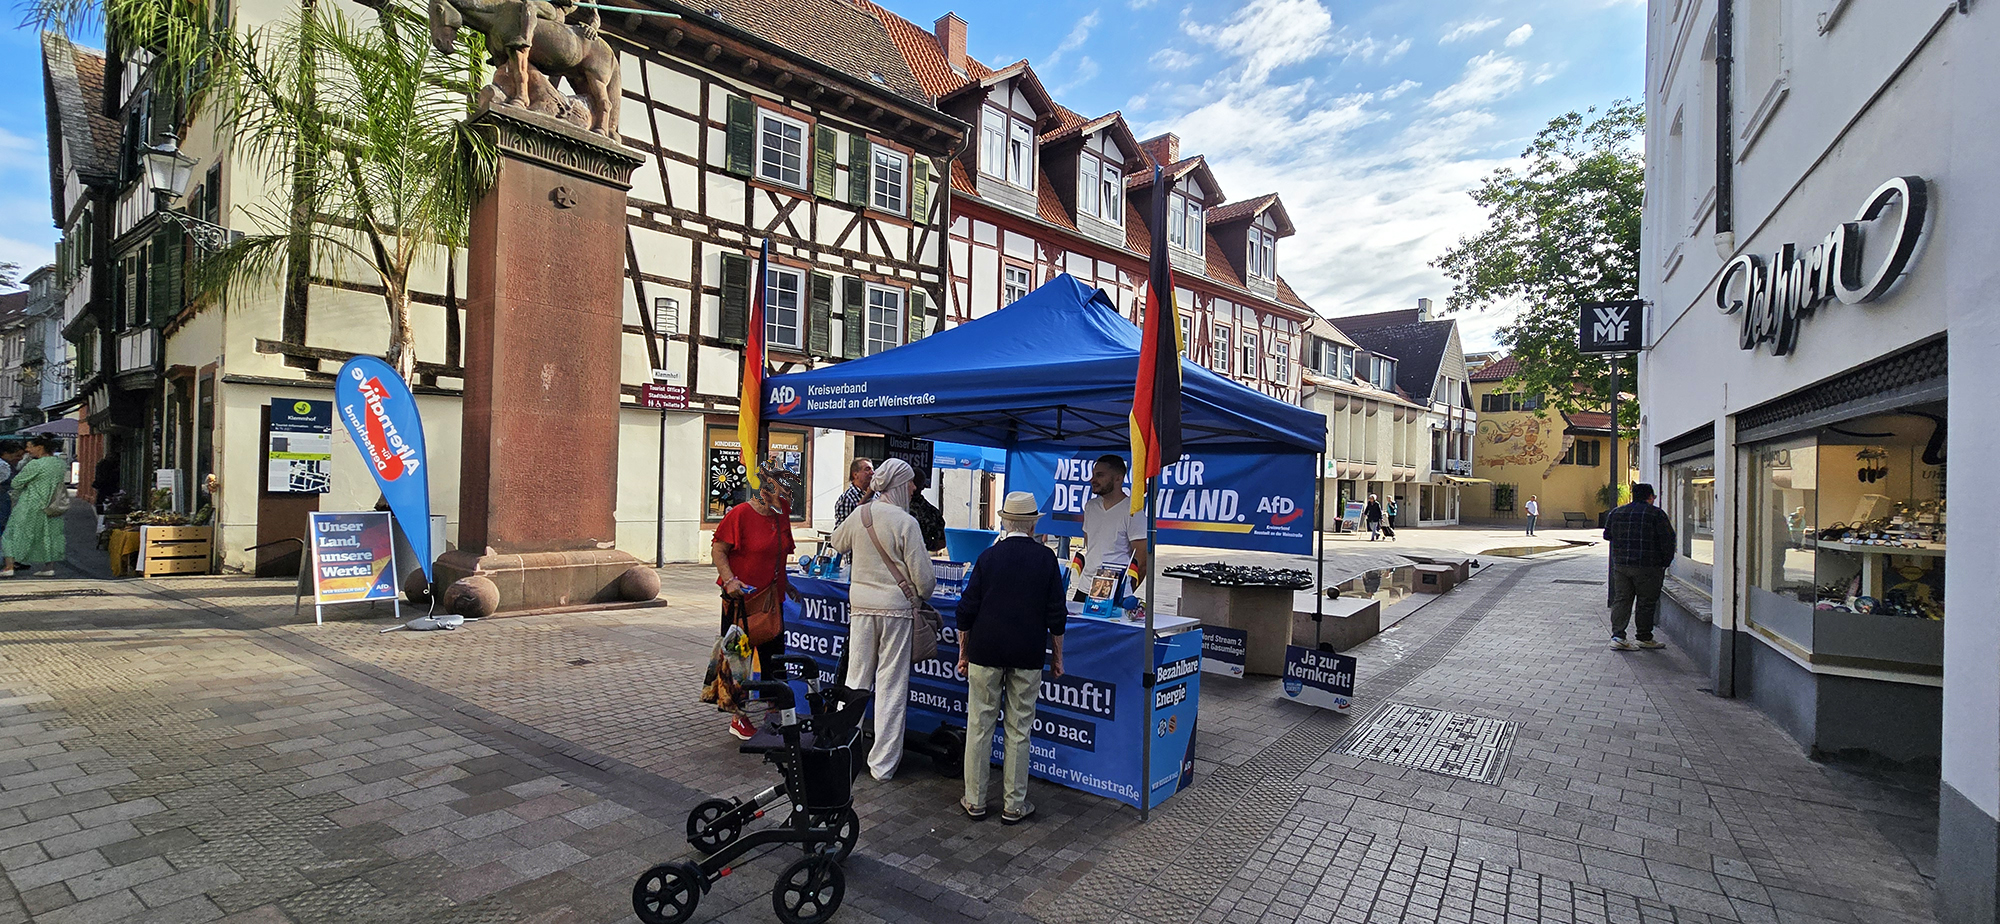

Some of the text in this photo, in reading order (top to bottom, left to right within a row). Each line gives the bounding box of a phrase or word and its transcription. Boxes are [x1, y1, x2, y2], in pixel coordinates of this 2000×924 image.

[1593, 306, 1630, 342] WMF
[655, 371, 678, 379] Klemmhof
[769, 385, 796, 404] AfD
[808, 382, 868, 396] Kreisverband
[807, 393, 936, 411] Neustadt an der Weinstraße
[771, 443, 798, 451] AKTUELLES
[889, 436, 929, 452] Unser Land
[1162, 454, 1204, 486] FÜR
[1256, 495, 1295, 515] AfD
[318, 521, 363, 532] Unser
[319, 535, 360, 548] Land,
[320, 551, 372, 562] unsere
[321, 564, 372, 577] Werte!
[803, 597, 837, 622] Wir
[784, 629, 828, 655] nsere
[1210, 643, 1246, 657] Gasumlage!
[1215, 634, 1237, 646] Stream
[1237, 638, 1242, 647] 2
[1301, 650, 1340, 671] Ja zur
[1156, 658, 1198, 683] Bezahlbare
[1287, 661, 1351, 688] Kernkraft!
[910, 689, 950, 713] вами,
[1155, 684, 1186, 708] Energie
[1334, 697, 1348, 706] AfD
[1058, 724, 1092, 745] вас.
[1033, 761, 1140, 801] an der Weinstraße
